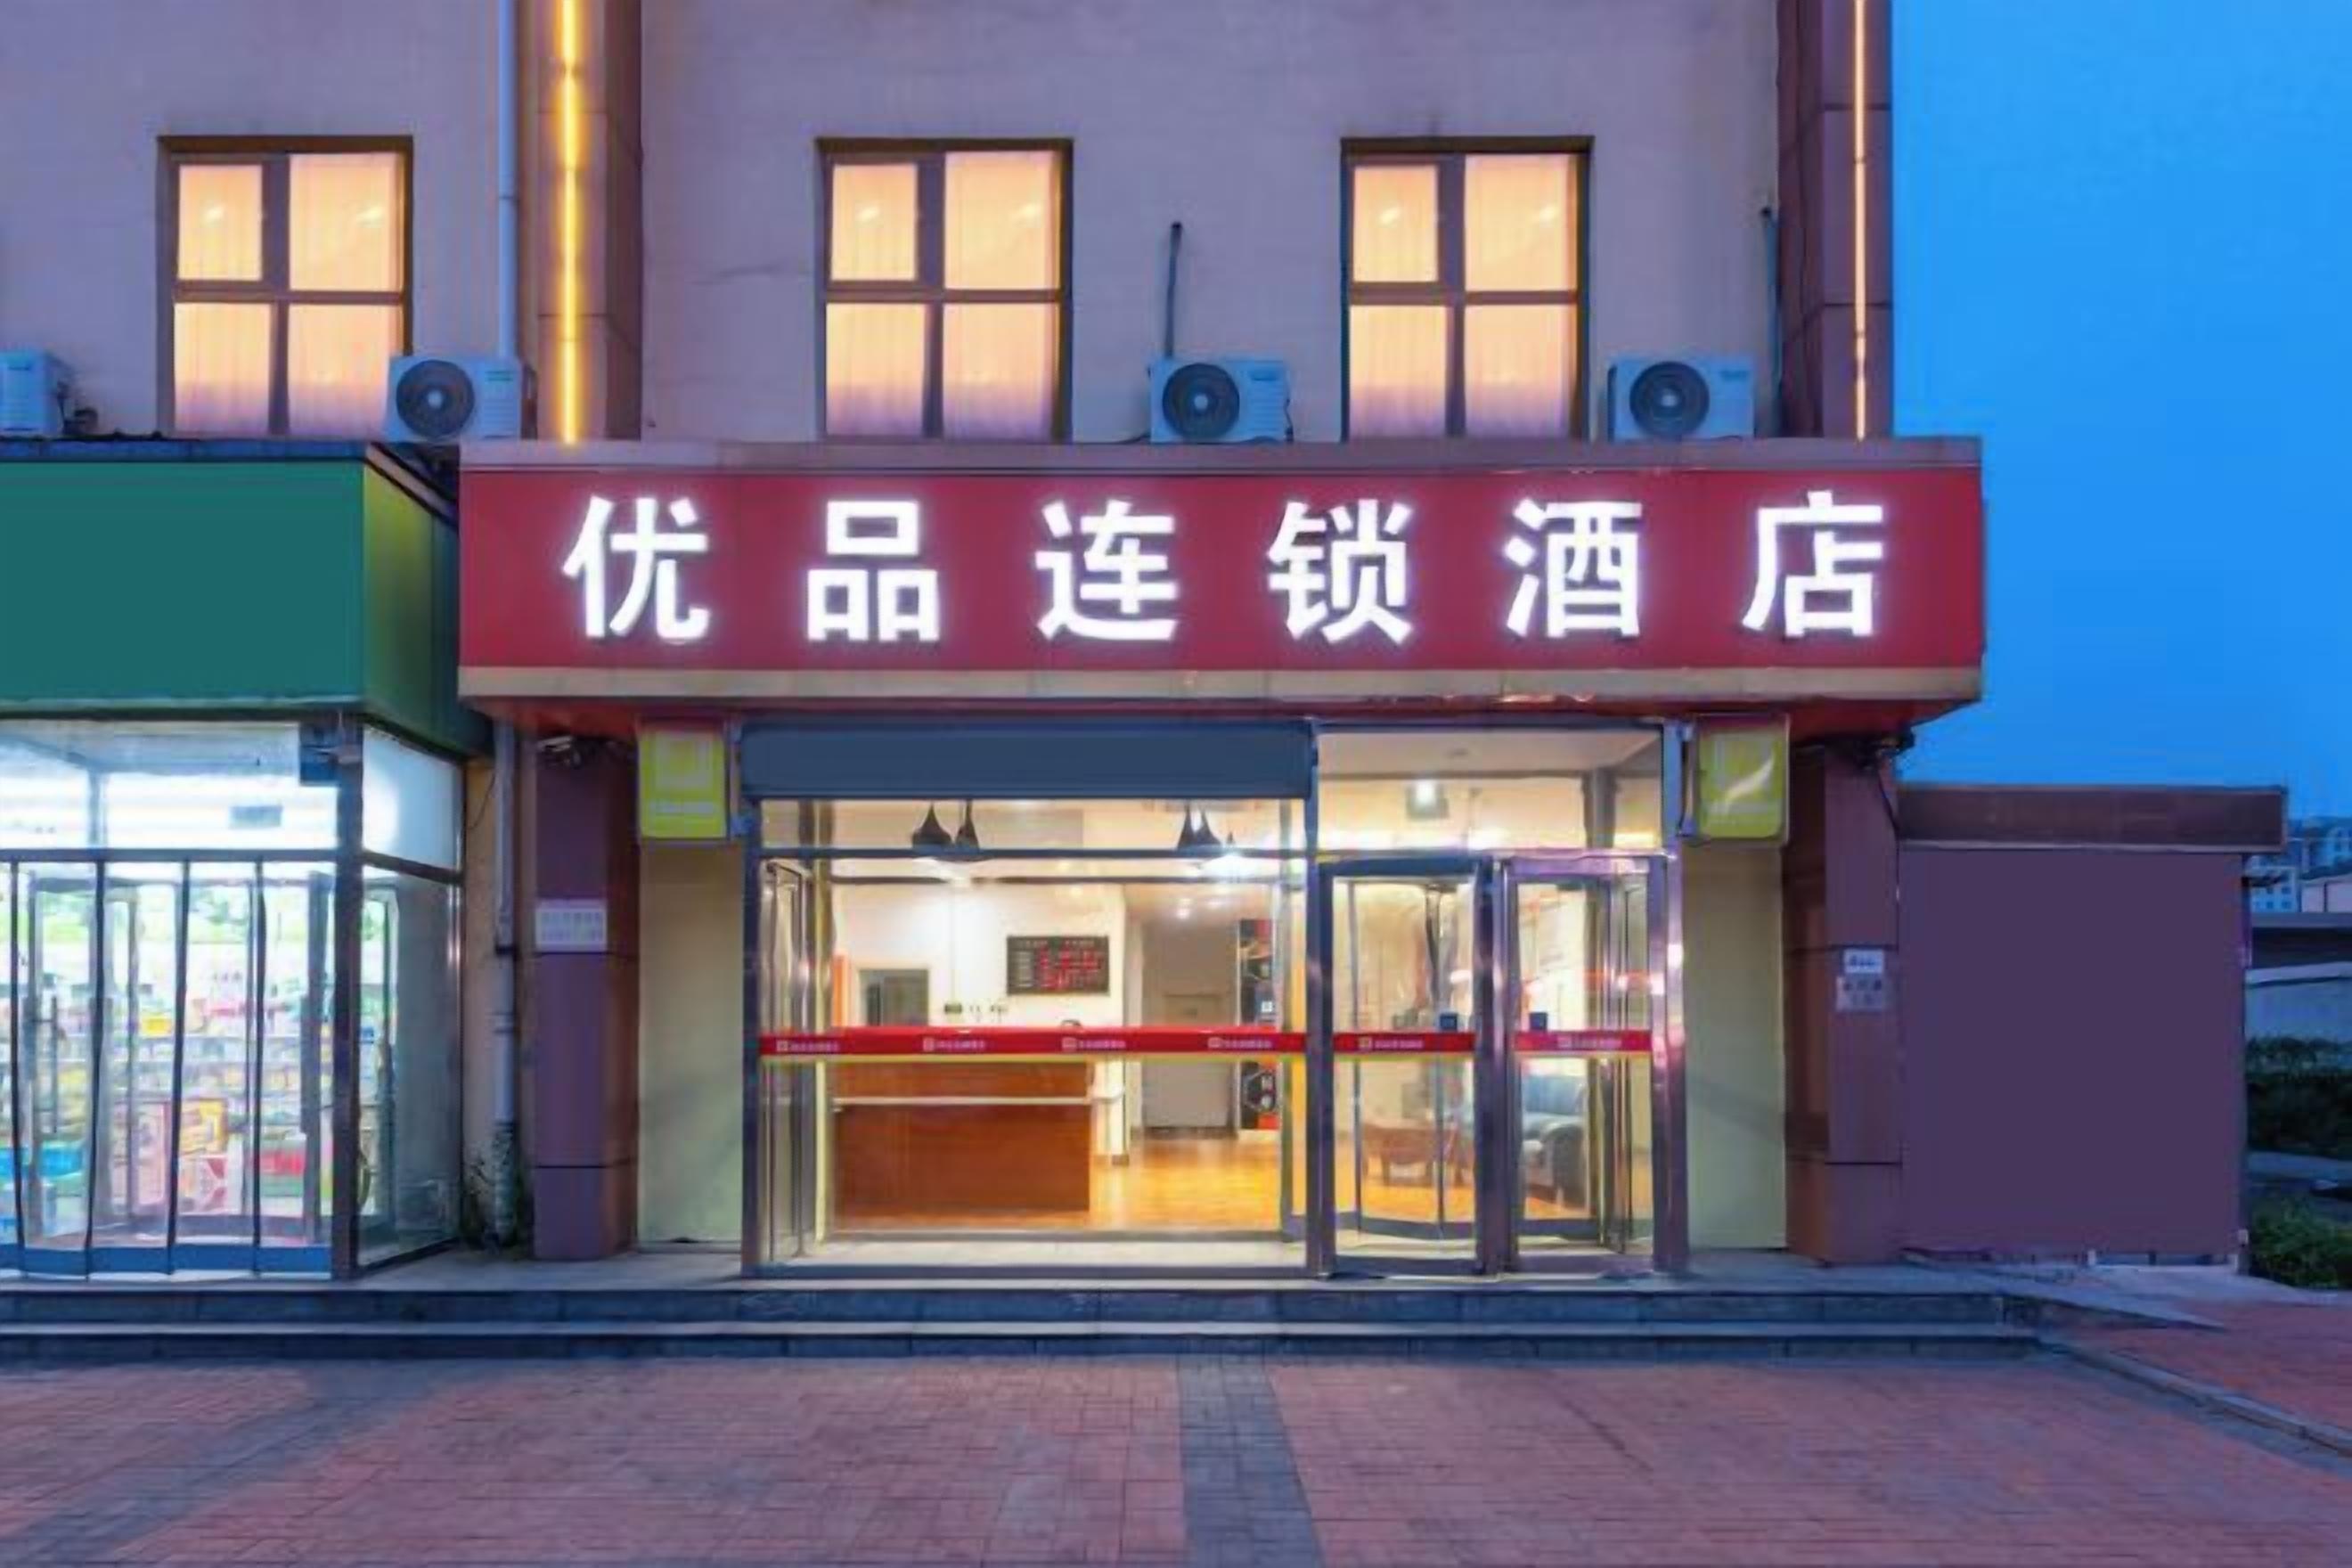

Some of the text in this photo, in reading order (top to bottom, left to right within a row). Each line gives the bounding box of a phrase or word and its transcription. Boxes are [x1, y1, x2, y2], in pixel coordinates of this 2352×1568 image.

[563, 491, 1882, 641] 优品连锁酒店
